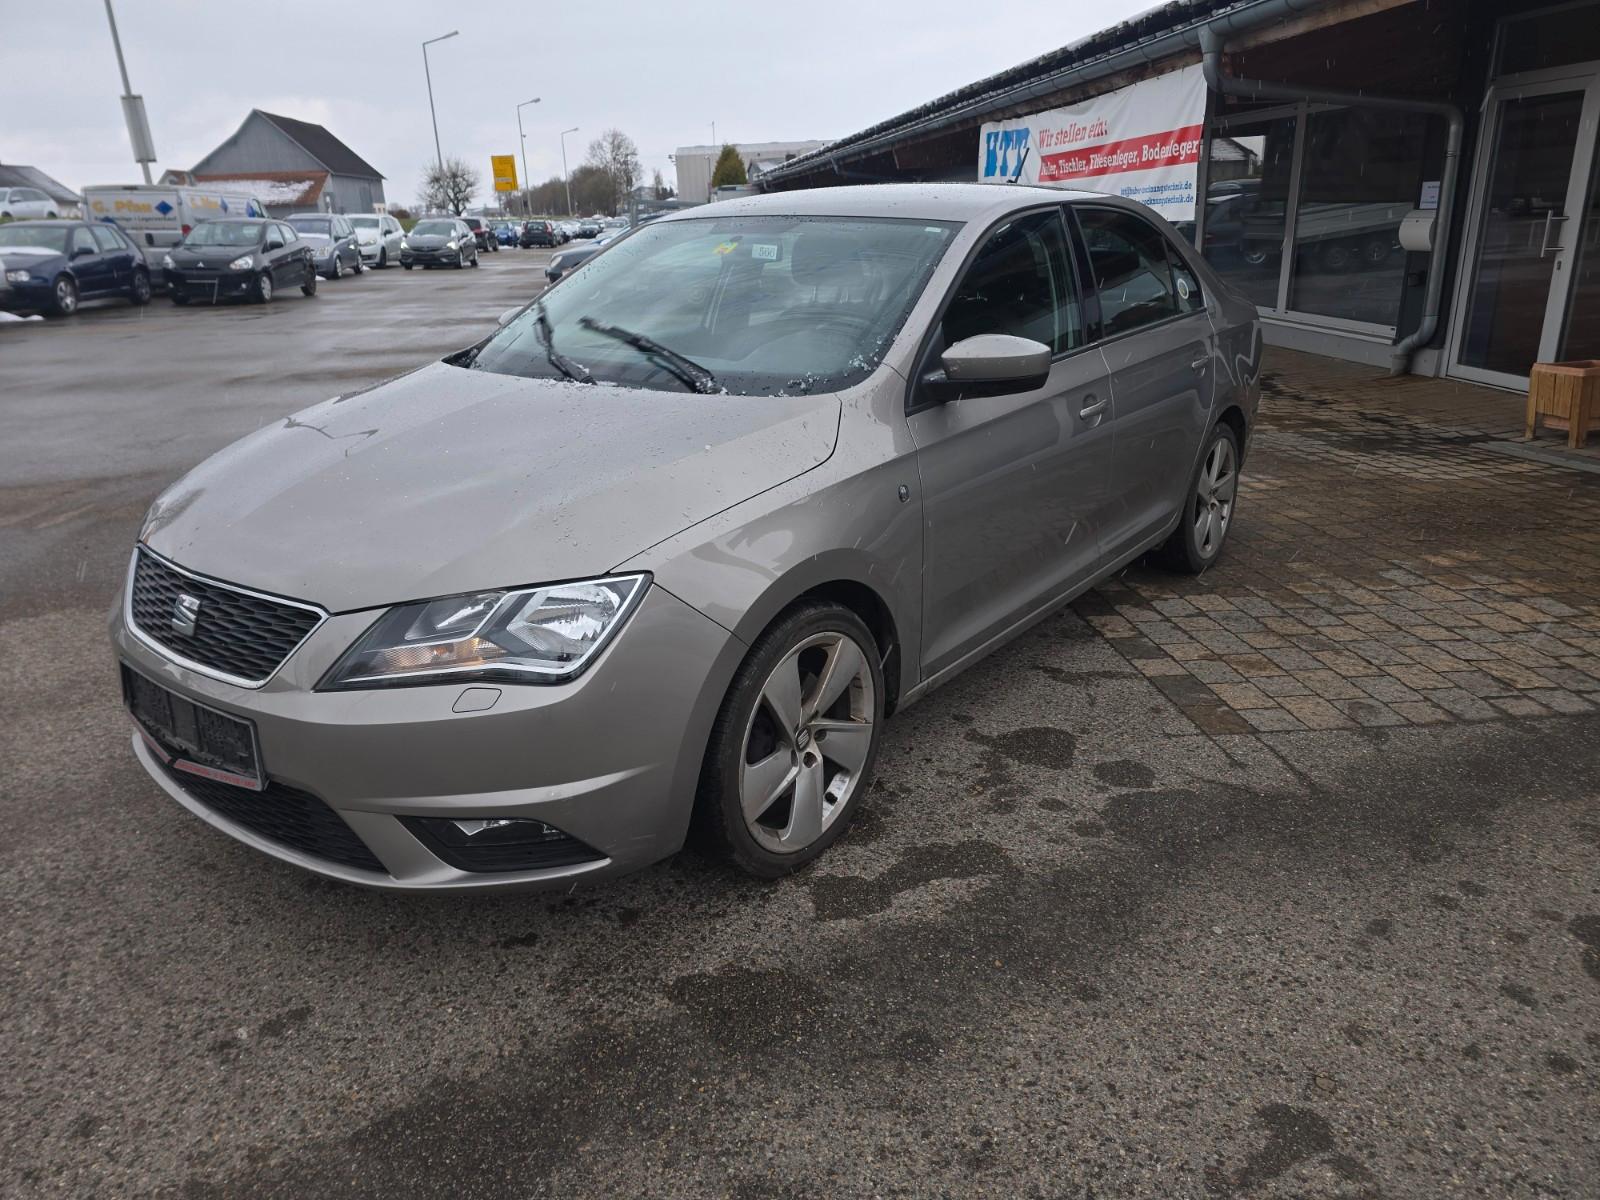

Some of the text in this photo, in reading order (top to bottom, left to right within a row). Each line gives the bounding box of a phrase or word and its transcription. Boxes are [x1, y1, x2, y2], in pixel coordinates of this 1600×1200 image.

[1039, 130, 1054, 148] Wir
[1055, 123, 1087, 147] stellen
[1059, 157, 1088, 174] Tischler,
[1142, 140, 1199, 162] Bodenleger
